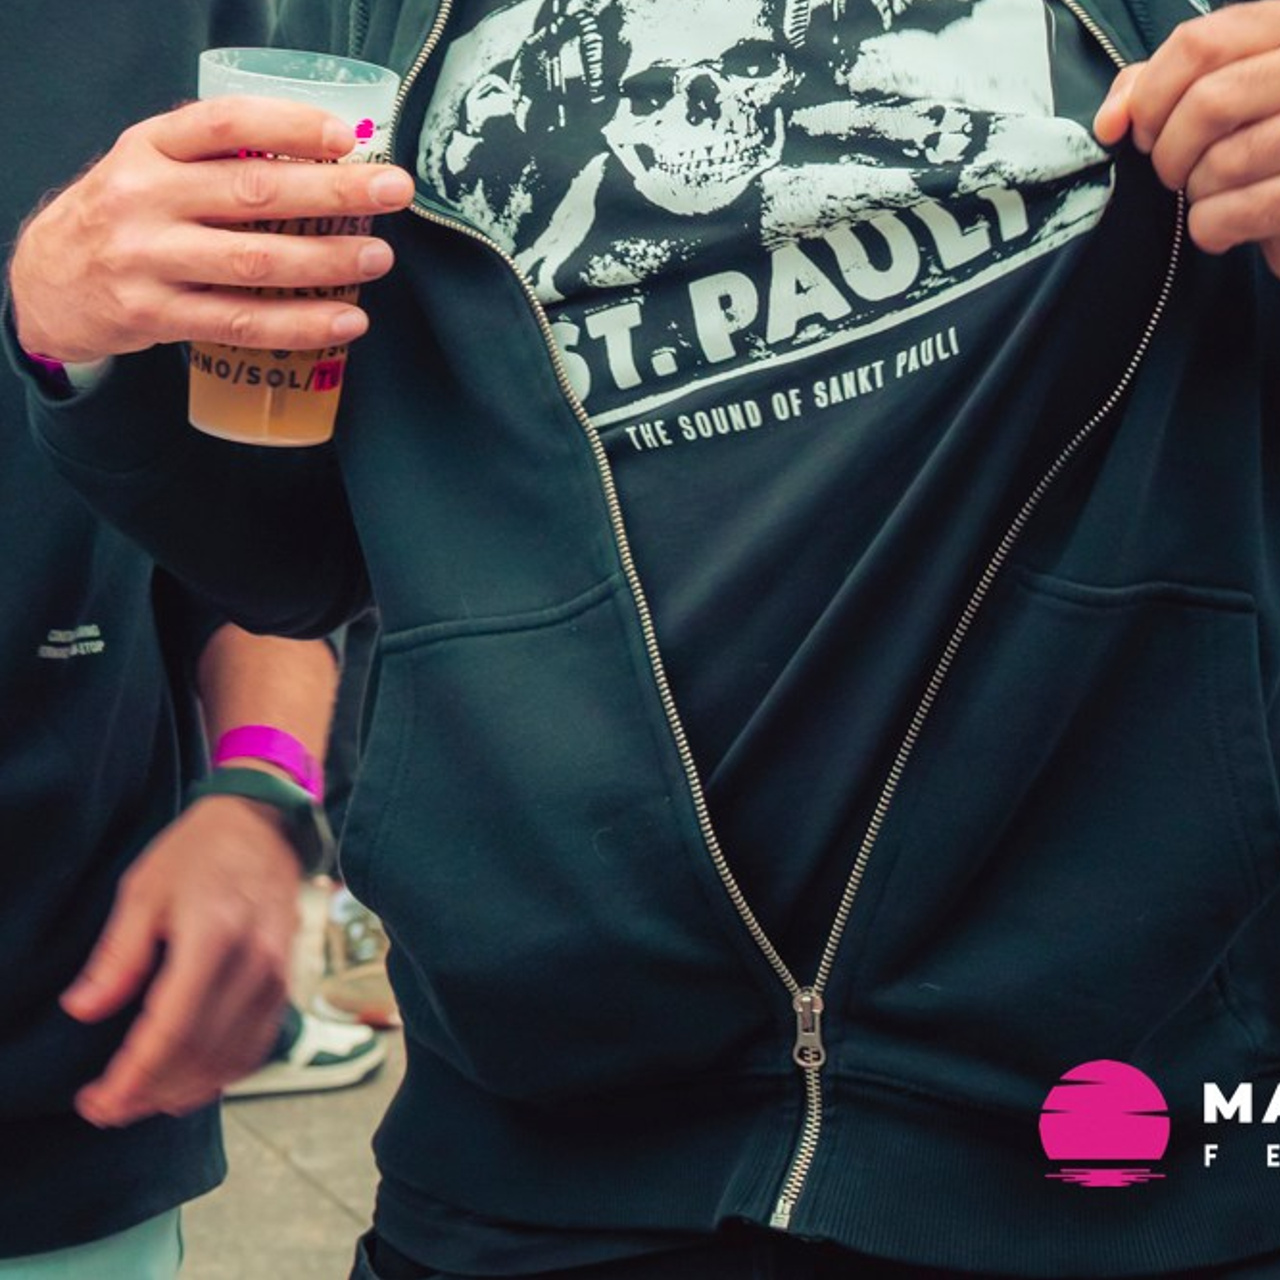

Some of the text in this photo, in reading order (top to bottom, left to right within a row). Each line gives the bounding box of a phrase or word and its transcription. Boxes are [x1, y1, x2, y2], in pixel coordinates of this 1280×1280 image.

[548, 301, 678, 402] ST.
[625, 326, 961, 453] THE SOUND OF SANKT PAULI
